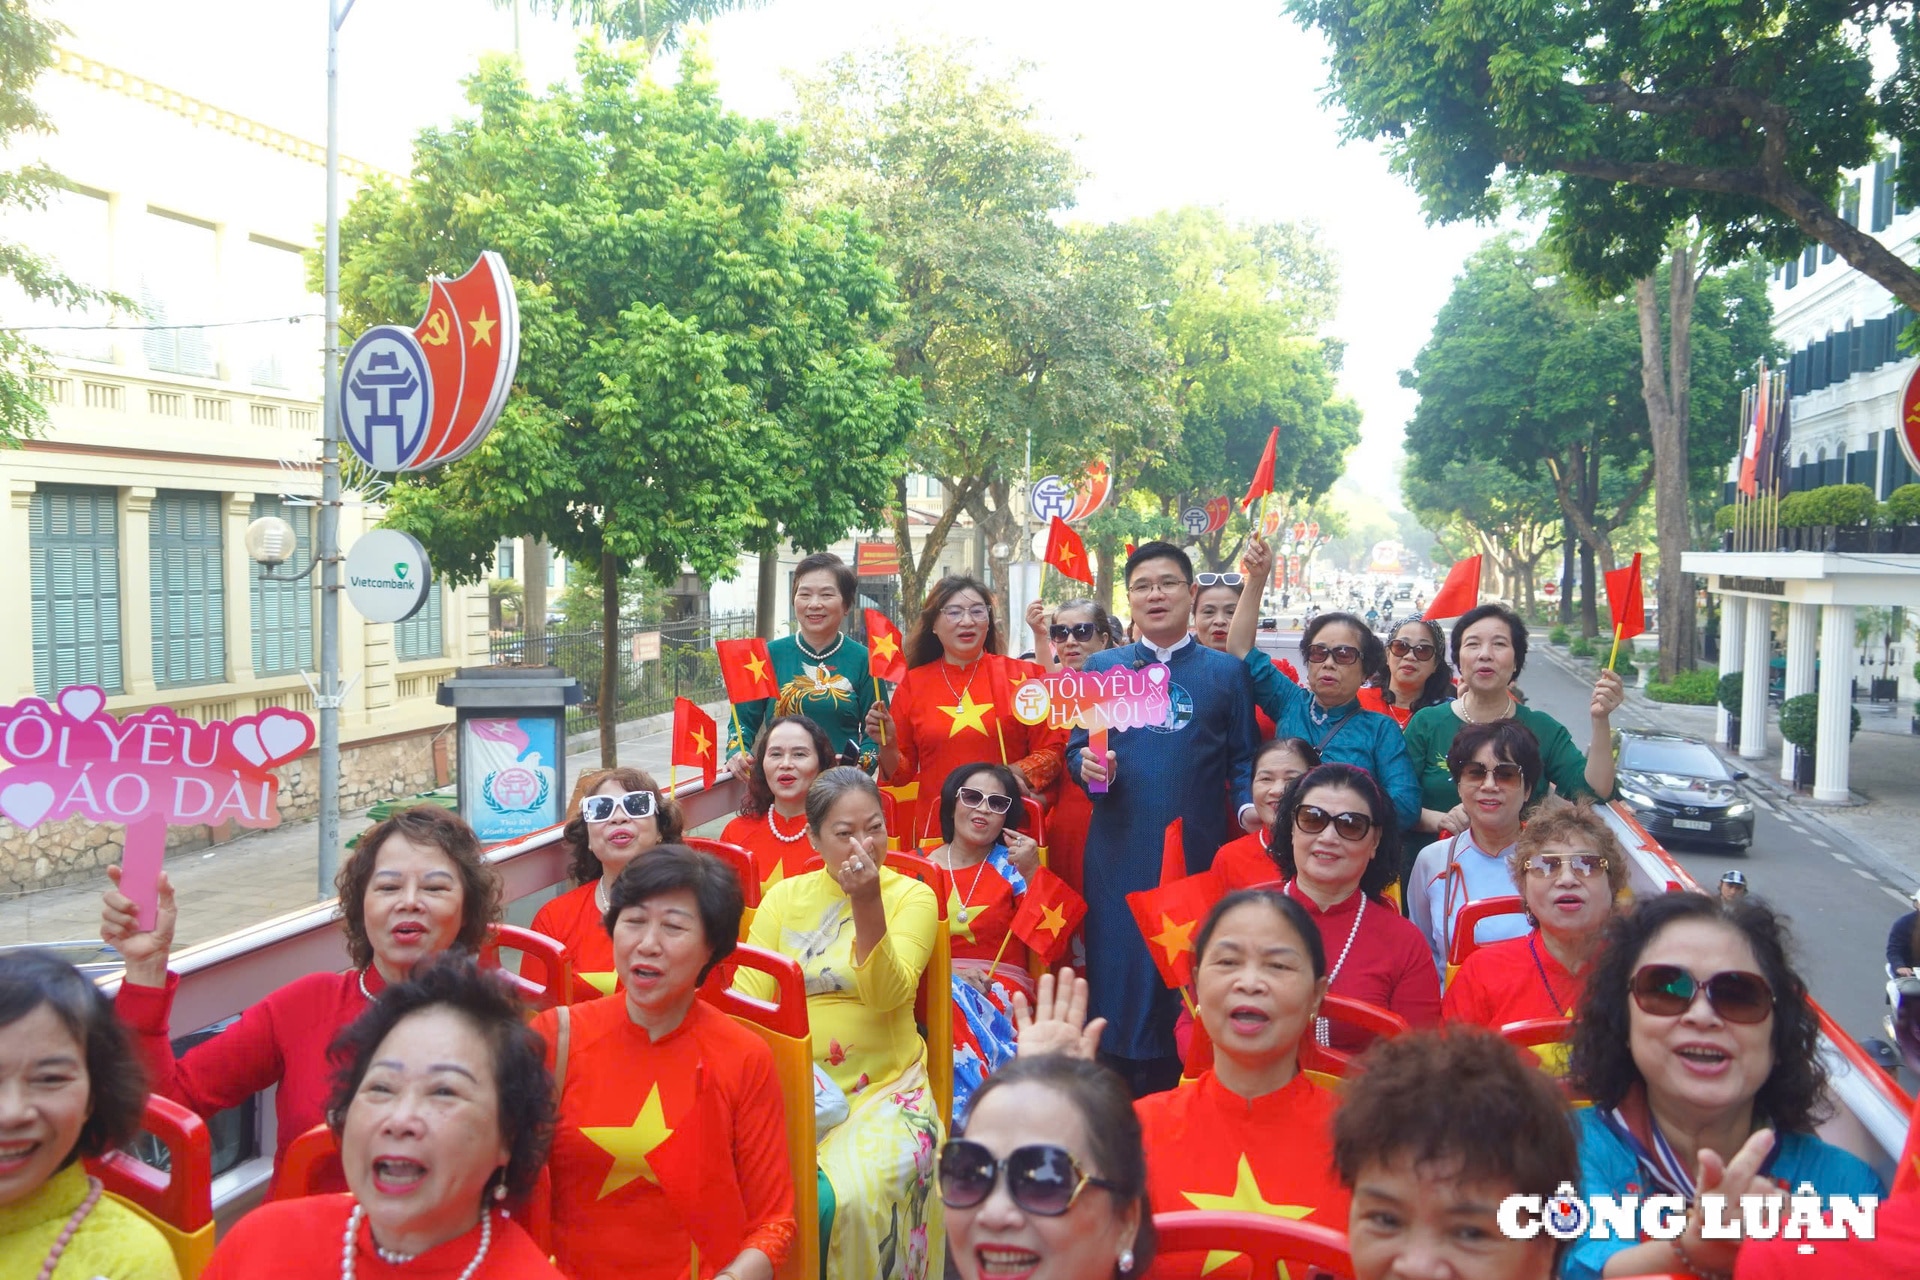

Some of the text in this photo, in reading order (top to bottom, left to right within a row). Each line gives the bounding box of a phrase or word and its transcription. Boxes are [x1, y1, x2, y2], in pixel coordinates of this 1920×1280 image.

[351, 576, 415, 590] Vietcombank
[1044, 670, 1145, 699] TÔI YÊU
[1050, 697, 1140, 727] HÀ NỘI
[0, 705, 220, 768] ÔI YÊU
[58, 762, 271, 821] ÁO DÀI
